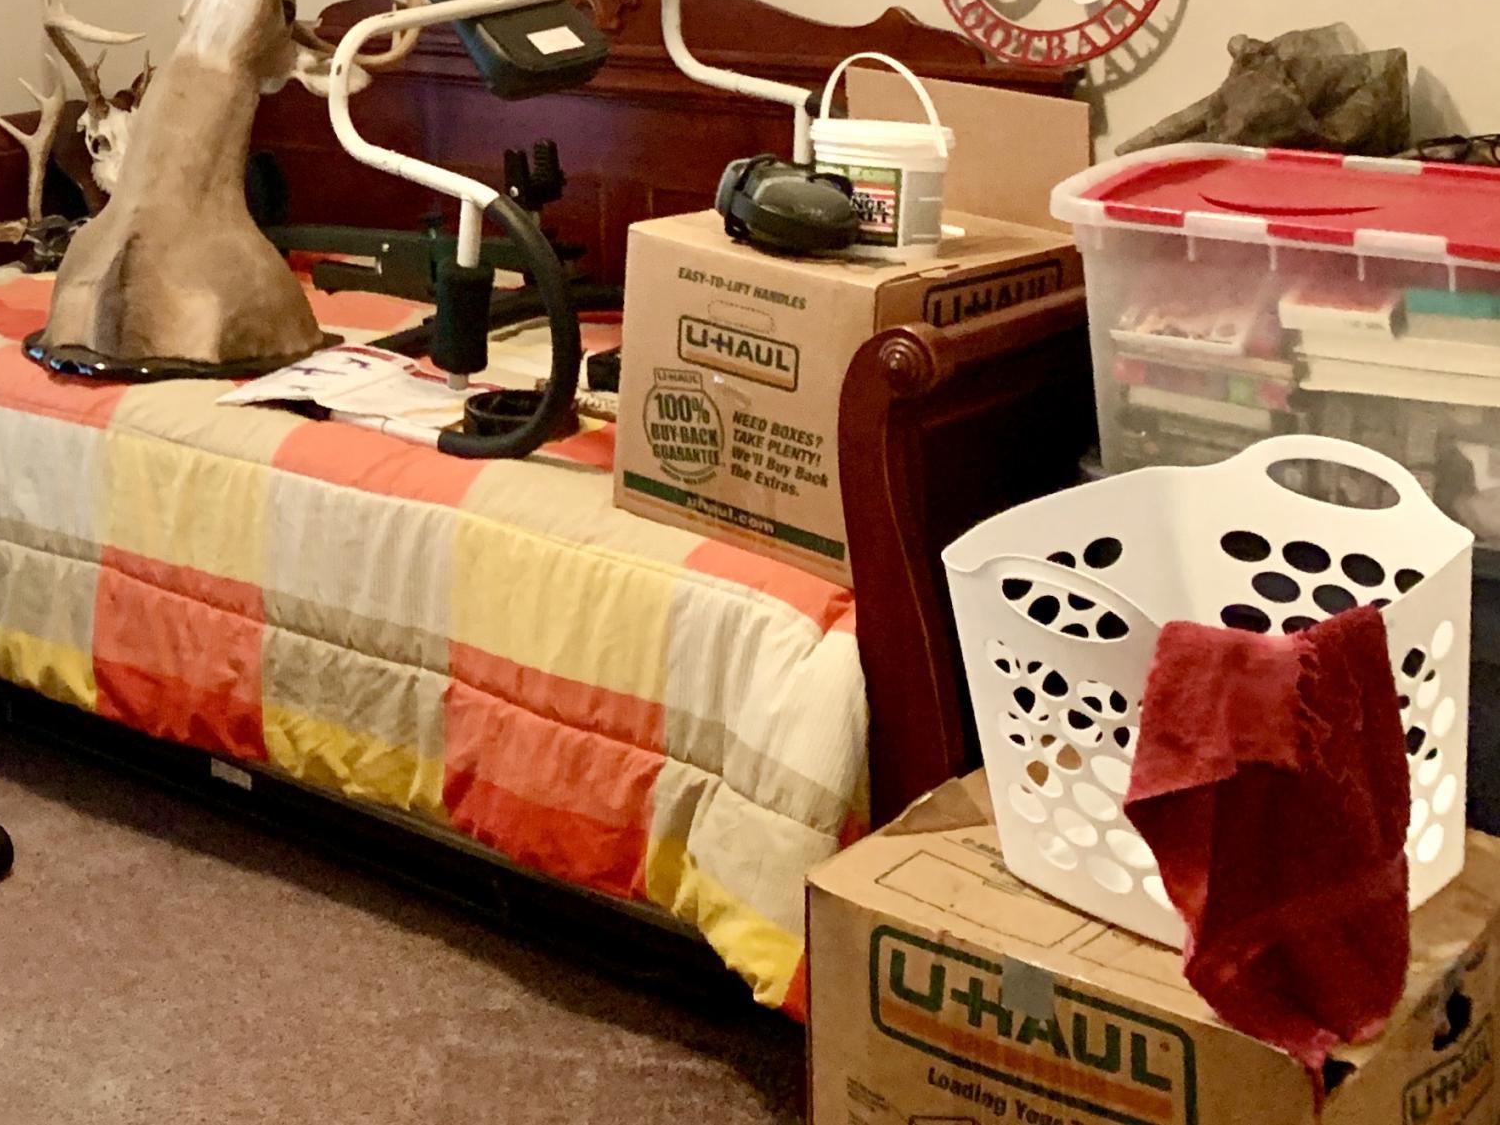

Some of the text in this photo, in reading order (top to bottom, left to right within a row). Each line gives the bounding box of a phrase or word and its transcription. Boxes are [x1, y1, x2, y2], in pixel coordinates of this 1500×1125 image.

[678, 267, 807, 310] EASY-TO-LIFT HANDLES
[686, 325, 790, 372] U-HAUL
[654, 392, 710, 425] 100%
[732, 411, 823, 449] NEED BOXES?
[731, 446, 829, 489] We'll Buy Back
[733, 429, 822, 467] TAKE PLENTY!
[730, 463, 752, 481] the
[755, 472, 800, 497] Extras.
[889, 949, 1173, 1092] U-HAUL
[927, 1067, 1007, 1117] Loading
